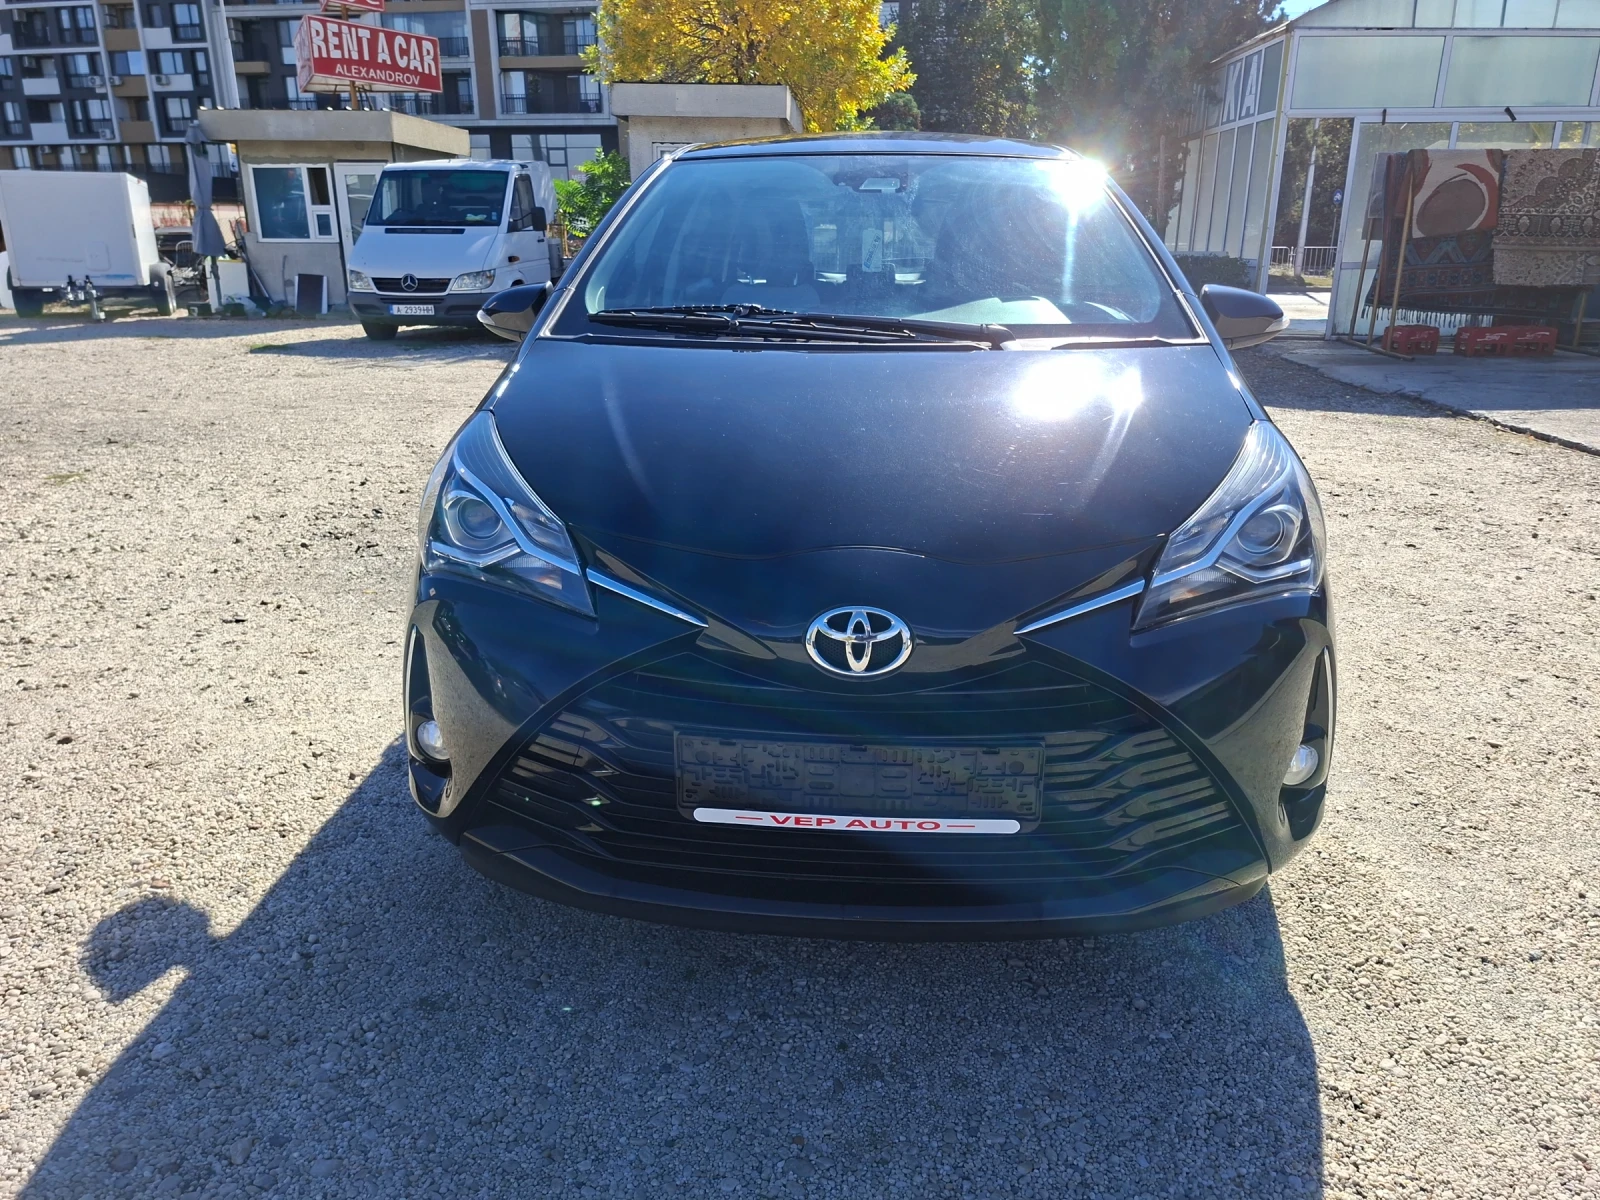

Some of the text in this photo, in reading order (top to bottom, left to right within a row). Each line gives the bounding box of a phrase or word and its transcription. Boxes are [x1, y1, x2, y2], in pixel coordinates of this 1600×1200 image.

[309, 20, 437, 76] RENT A CAR
[335, 63, 420, 85] ALEXANDROV
[769, 815, 941, 830] VEP AUTO
